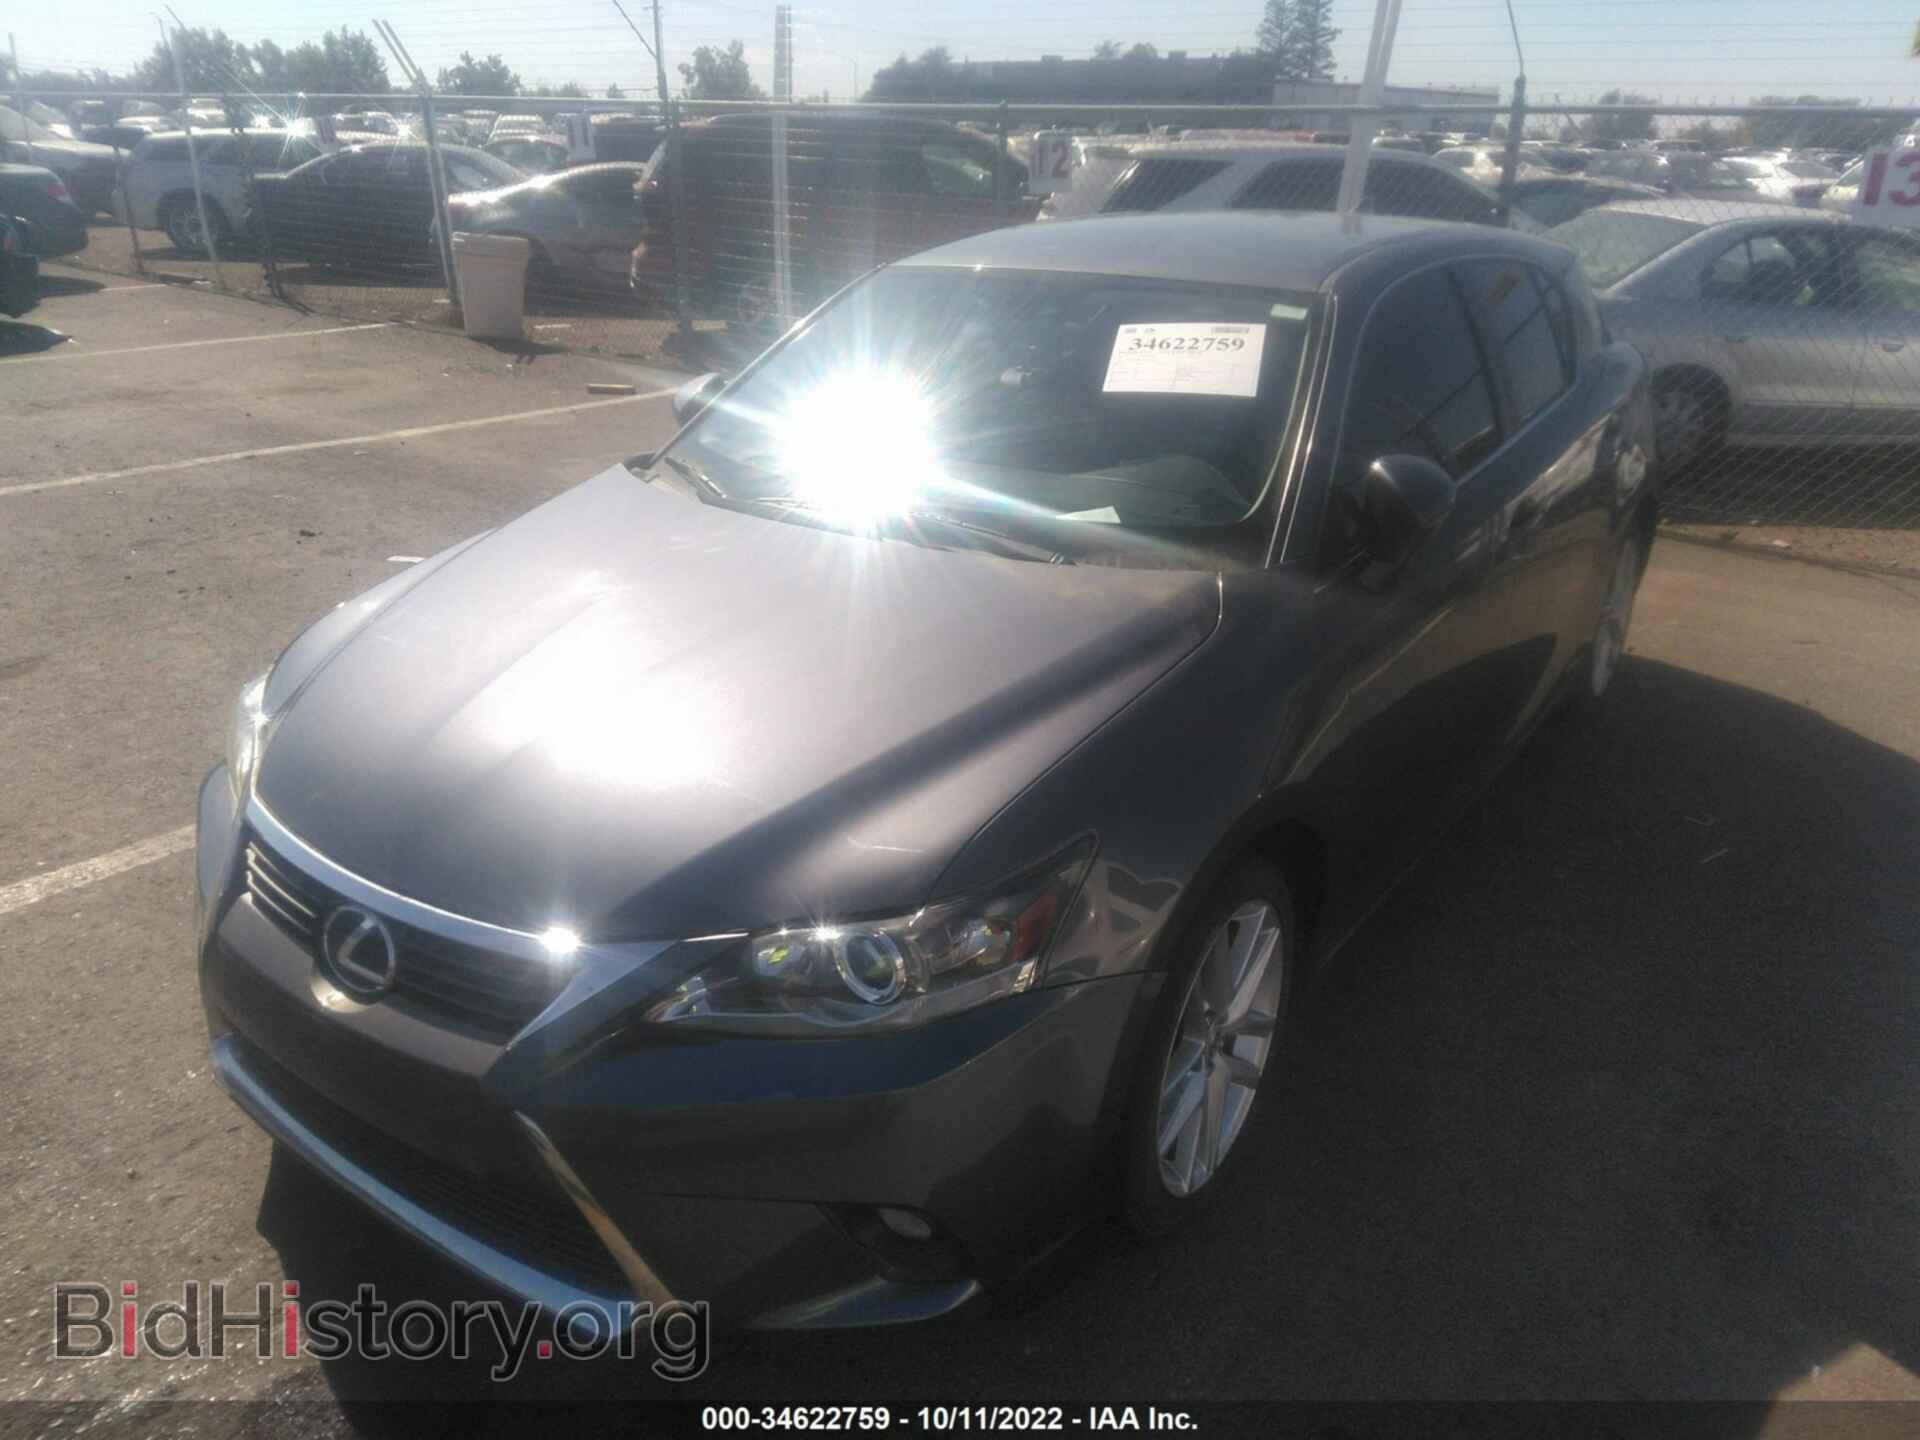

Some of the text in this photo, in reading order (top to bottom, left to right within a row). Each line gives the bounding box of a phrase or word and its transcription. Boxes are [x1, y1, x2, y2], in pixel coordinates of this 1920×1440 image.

[1032, 143, 1072, 179] 12
[1863, 151, 1920, 207] 13
[1127, 337, 1246, 352] 34622759
